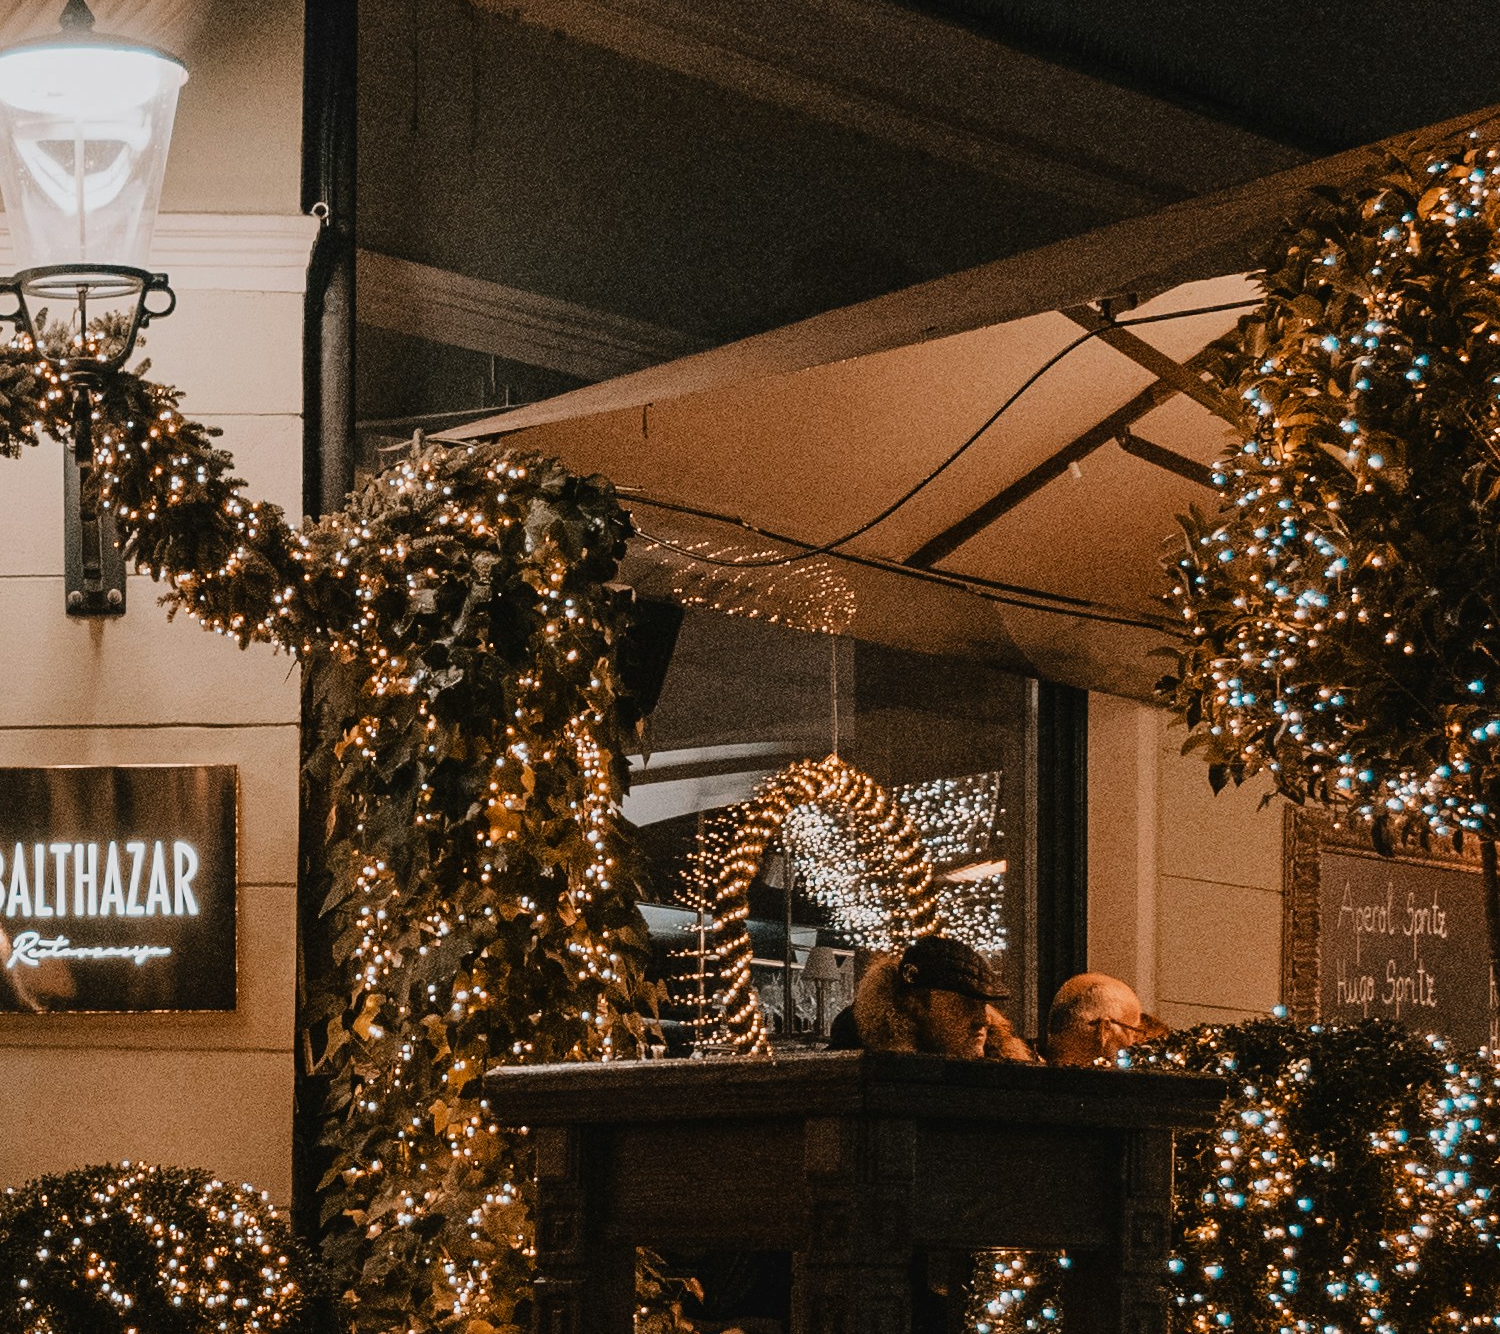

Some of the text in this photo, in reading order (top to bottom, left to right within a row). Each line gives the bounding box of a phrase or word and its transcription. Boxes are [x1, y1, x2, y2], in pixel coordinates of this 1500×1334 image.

[1338, 880, 1396, 967] Aperol
[1336, 957, 1437, 1019] Hugo Spritz
